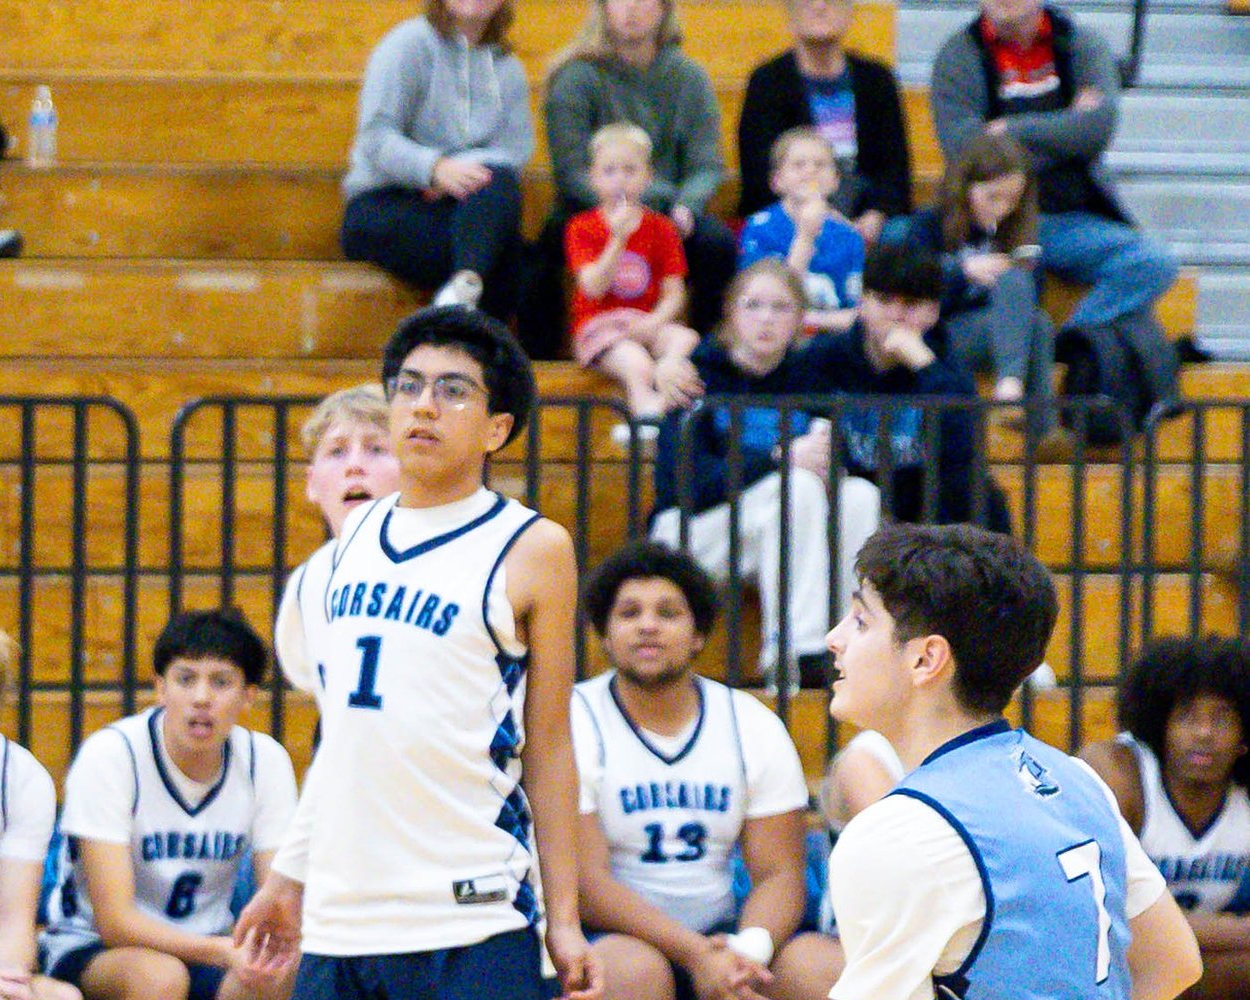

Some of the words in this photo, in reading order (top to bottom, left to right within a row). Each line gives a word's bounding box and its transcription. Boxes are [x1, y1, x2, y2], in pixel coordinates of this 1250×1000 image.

[348, 635, 383, 710] 1
[639, 822, 706, 863] 13
[166, 870, 203, 919] 6
[1056, 838, 1113, 986] 7
